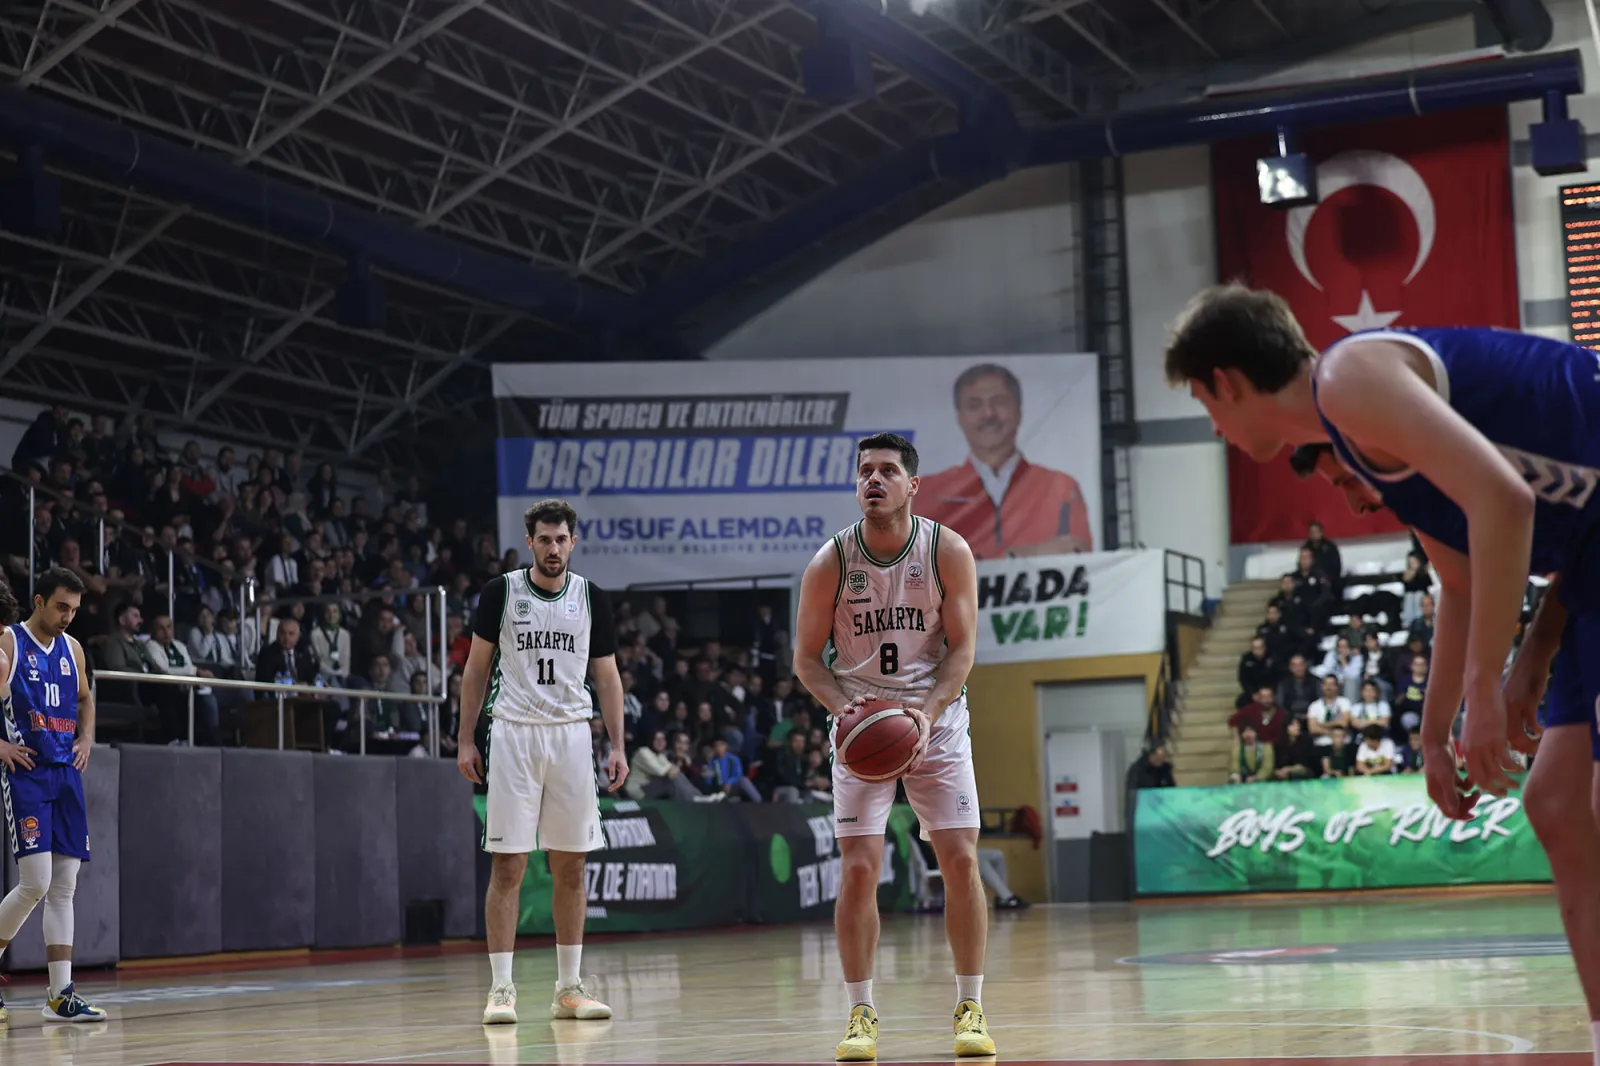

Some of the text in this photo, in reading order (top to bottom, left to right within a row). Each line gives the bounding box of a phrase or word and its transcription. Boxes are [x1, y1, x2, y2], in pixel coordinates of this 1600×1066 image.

[538, 395, 838, 430] TÜM SPORCU VE ANTRENÖRLERE
[527, 440, 740, 497] BAŞARILAR
[578, 516, 825, 541] YUSUF ALEMDAR
[853, 607, 926, 636] SAKARYA
[990, 600, 1089, 645] VAR!
[517, 631, 575, 654] SAKARYA
[537, 658, 556, 685] 11
[880, 643, 898, 675] 8
[44, 682, 60, 708] 10
[1206, 806, 1315, 857] BOYS
[1323, 803, 1389, 845] OF
